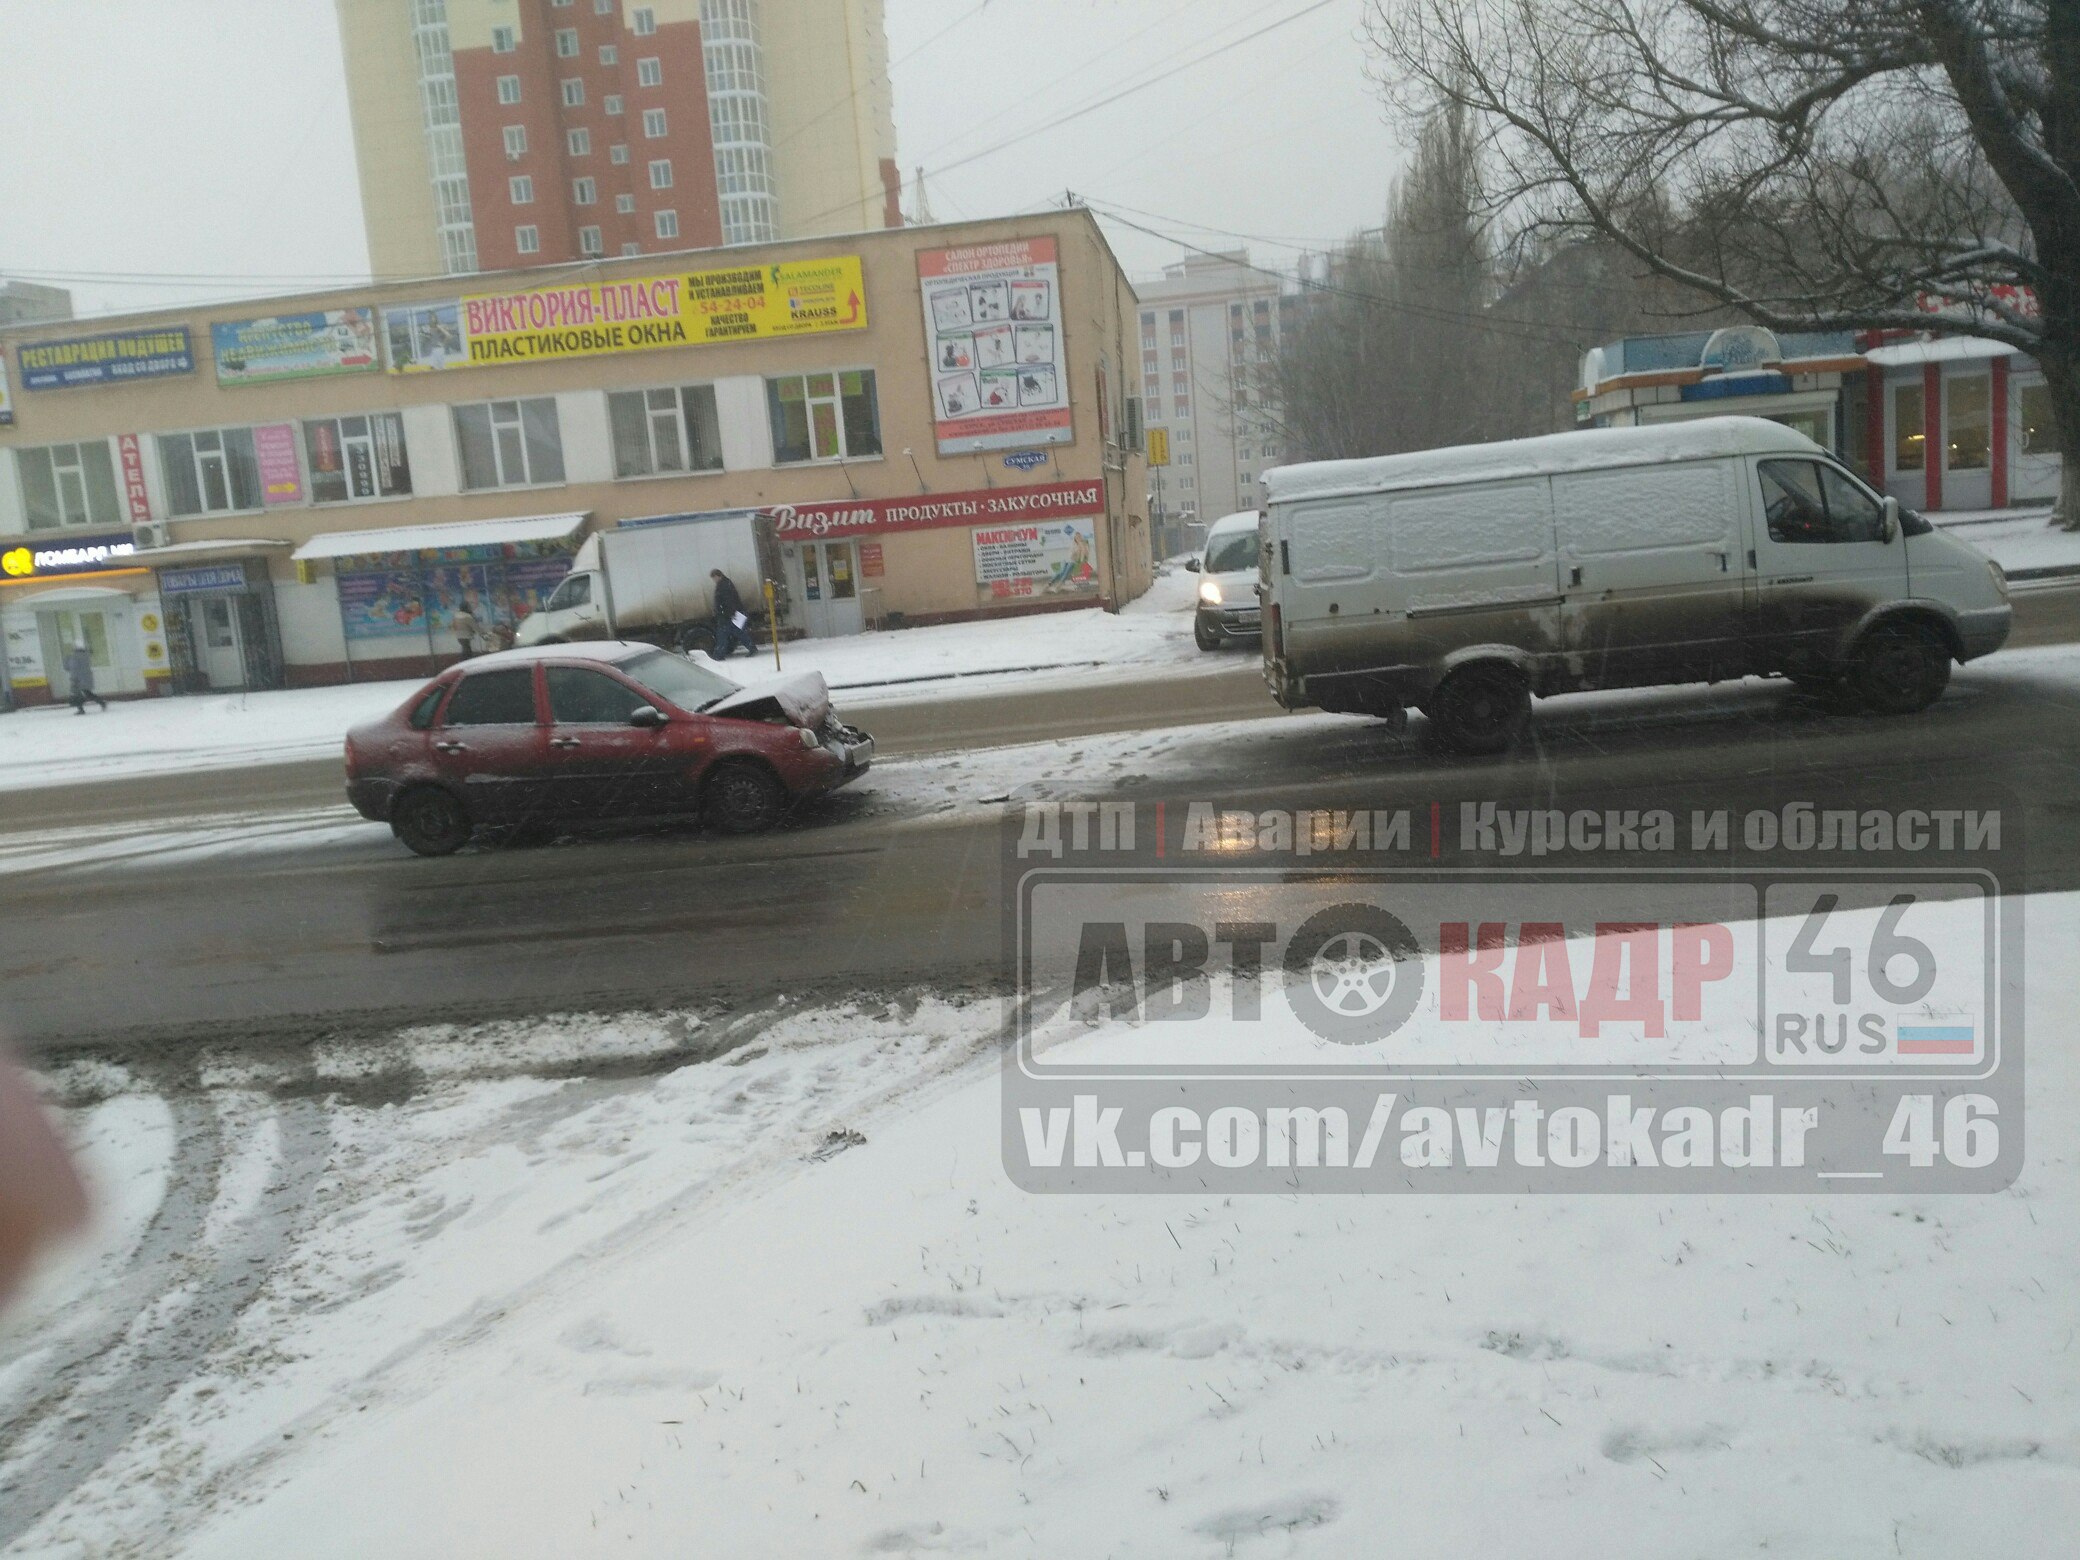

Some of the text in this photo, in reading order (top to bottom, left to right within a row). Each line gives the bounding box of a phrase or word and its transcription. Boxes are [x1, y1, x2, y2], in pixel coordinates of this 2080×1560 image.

[688, 269, 762, 288] МЫ ПРОИЗВОДИМ
[780, 267, 842, 281] SALAMANDER
[466, 278, 681, 335] ВИКТОРИЯ-ПЛАСТ
[700, 295, 765, 315] 54-24-04
[791, 306, 837, 320] KRAUSS
[710, 312, 749, 326] КАЧЕСТВО
[471, 320, 686, 361] ПЛАСТИКОВЫЕ ОКНА
[1005, 454, 1046, 466] СУМСКАЯ
[122, 436, 149, 520] АТЕЛЬ
[769, 503, 877, 535] Визит
[885, 499, 977, 523] ПРОДУКТЫ
[987, 487, 1098, 514] ЗАКУСОЧНАЯ
